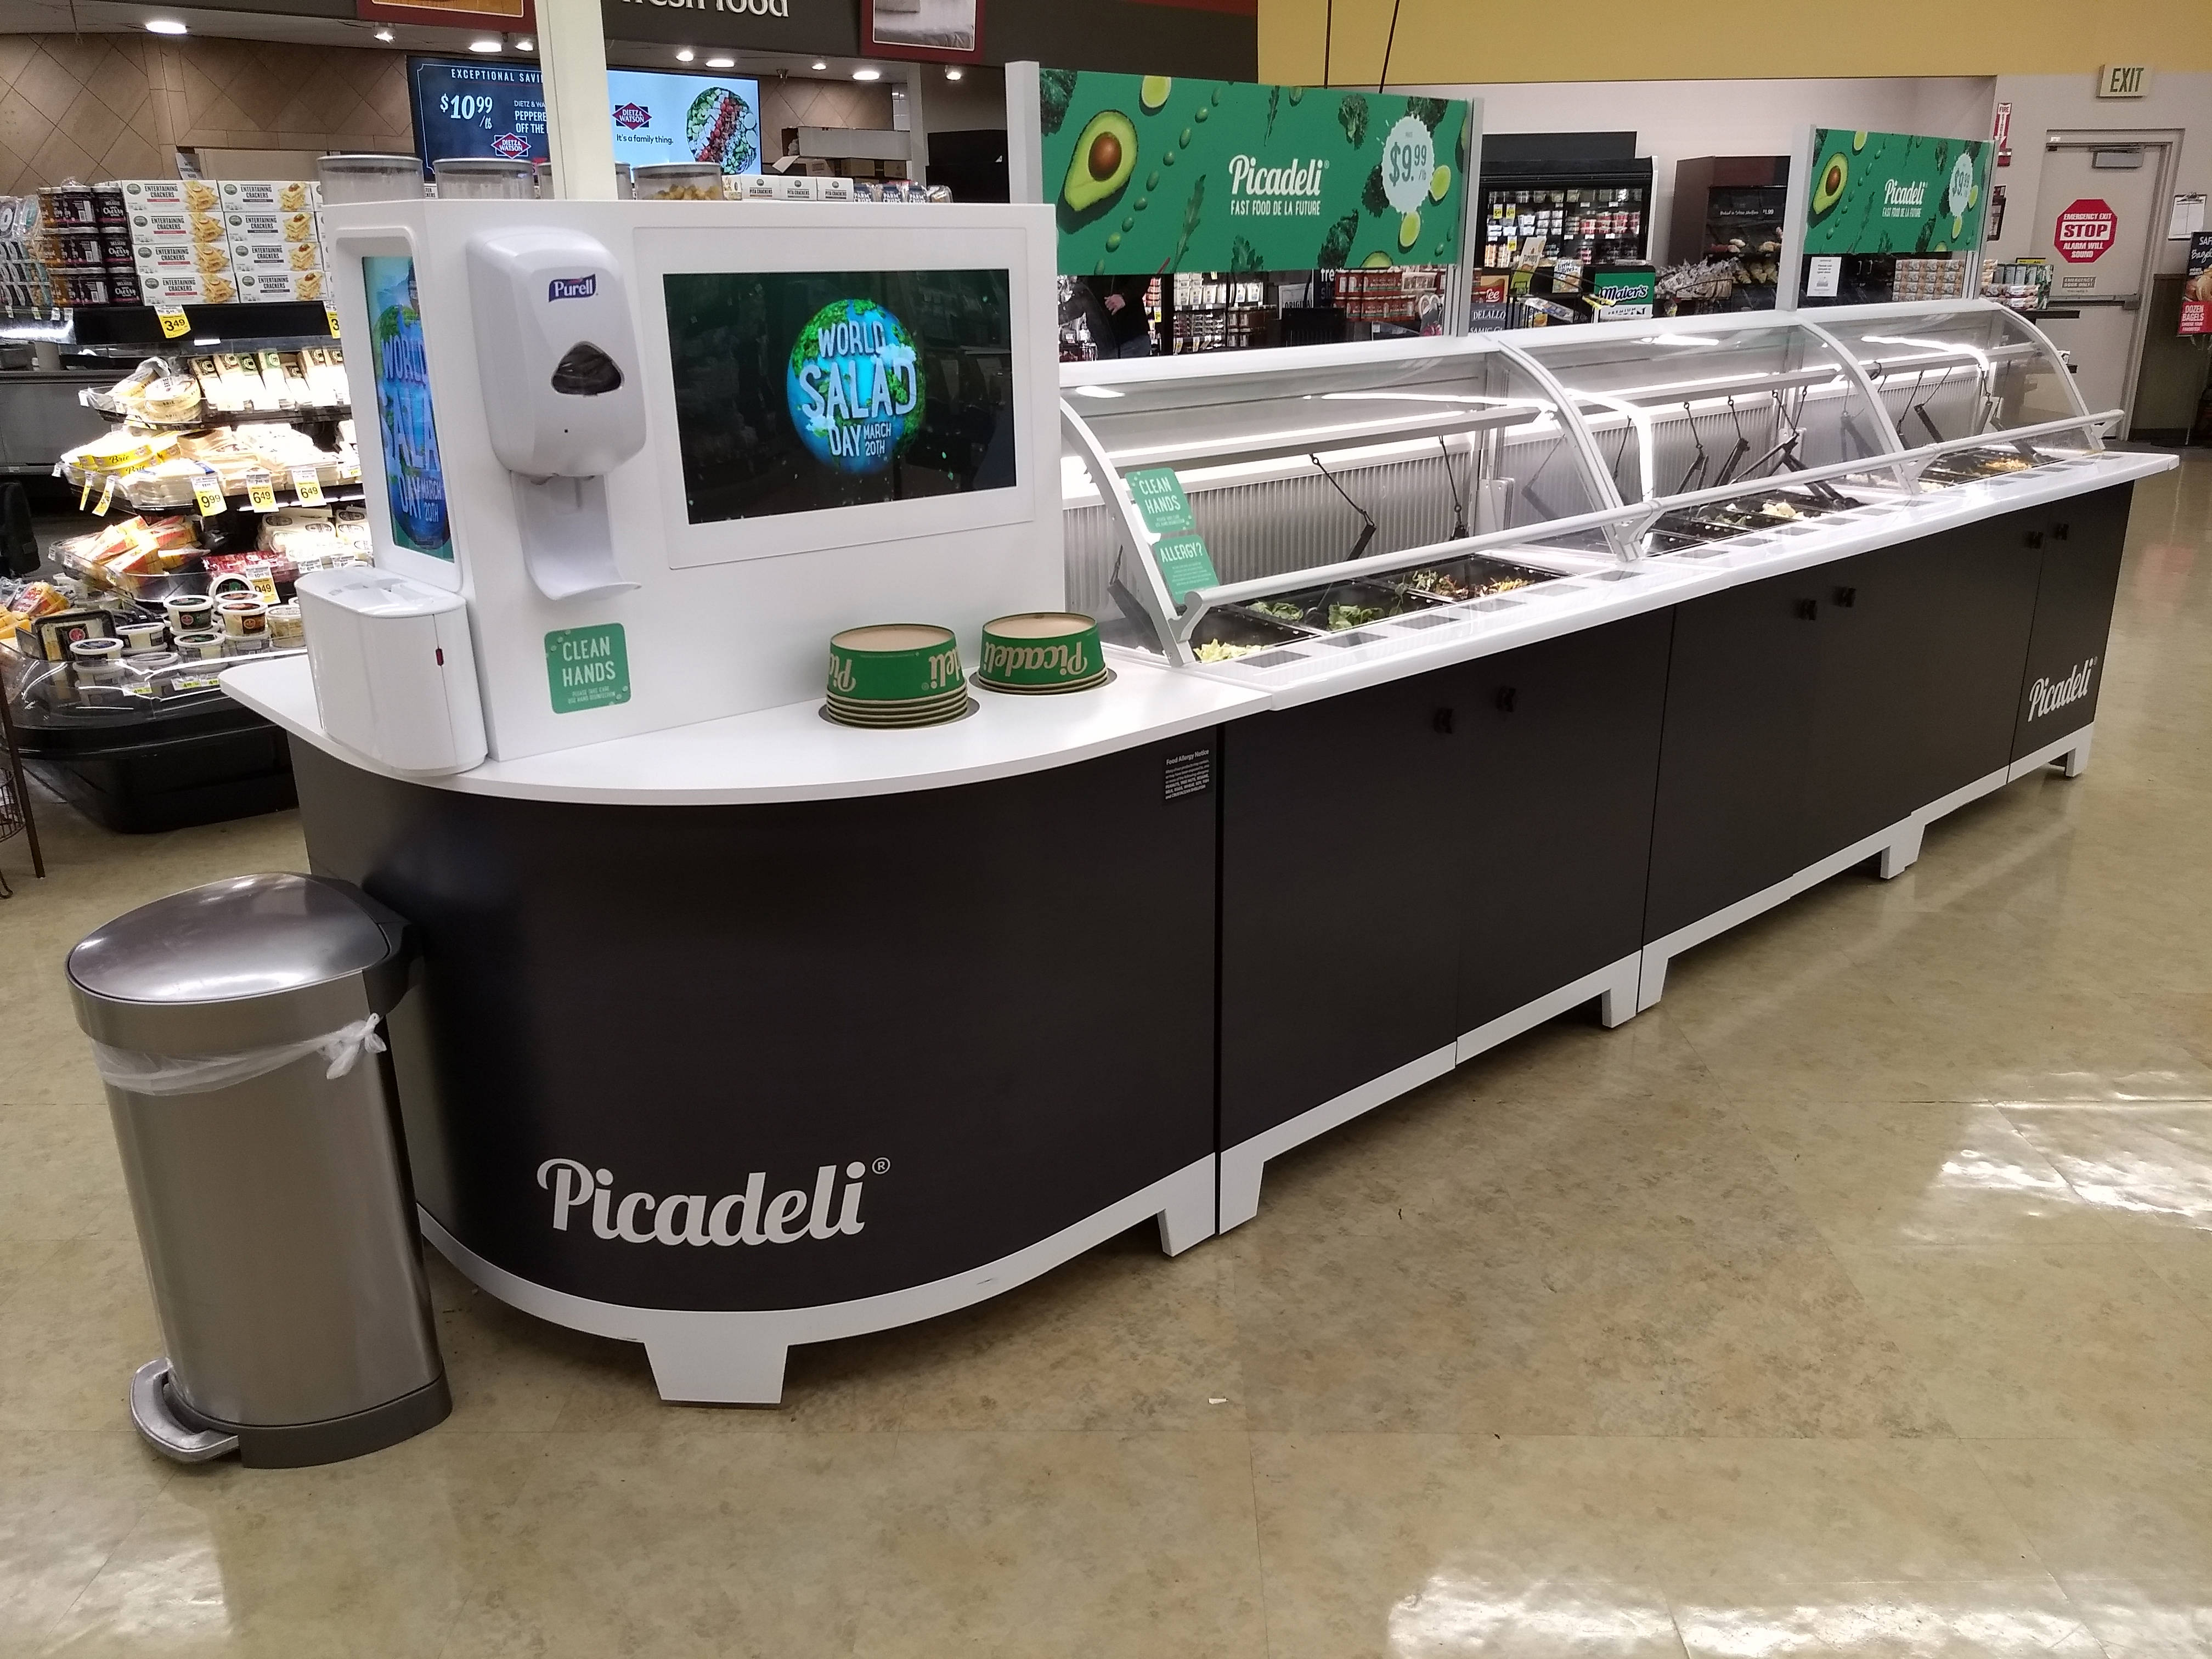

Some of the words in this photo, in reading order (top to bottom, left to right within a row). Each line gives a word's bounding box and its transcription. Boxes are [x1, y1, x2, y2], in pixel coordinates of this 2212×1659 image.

[451, 68, 515, 82] EXCEPTIONAL
[519, 73, 543, 83] SAVI
[2109, 67, 2144, 92] EXIT
[516, 123, 529, 133] OFF
[531, 123, 545, 134] THE
[633, 134, 654, 144] family
[654, 136, 674, 145] thing.
[1229, 154, 1323, 196] Picadeli
[1884, 179, 1926, 205] Picadeli
[1231, 200, 1250, 216] FAST
[1252, 200, 1271, 216] FOOD
[1273, 200, 1282, 216] DE
[1284, 200, 1293, 216] LA
[1295, 200, 1321, 216] FUTURE
[2063, 224, 2108, 238] STOP
[554, 278, 593, 297] Purell
[1601, 285, 1648, 301] Maier's
[1284, 300, 1313, 308] ORIGIAL
[2185, 304, 2204, 313] DOZEN
[1473, 310, 1506, 320] DELALLO
[2182, 313, 2204, 321] BAGELS
[818, 321, 885, 358] WORLD
[381, 335, 428, 383] WORLD
[799, 358, 917, 420] SALAD
[828, 425, 862, 457] DAY
[863, 422, 891, 440] MARCH
[865, 441, 885, 456] 20TH
[109, 455, 130, 464] Brie
[397, 472, 421, 520] DAY
[1139, 477, 1172, 495] CLEAN
[424, 502, 439, 522] 20TH
[1145, 495, 1181, 515] HANDS
[1160, 541, 1203, 563] ALLERGY?
[562, 636, 611, 661] CLEAN
[983, 640, 1088, 678] Picadeli
[562, 661, 616, 687] HANDS
[2028, 657, 2094, 723] Picadeli
[1166, 757, 1178, 765] Food
[1178, 753, 1195, 763] Allergy
[1194, 749, 1210, 758] Notice
[536, 1158, 866, 1247] Picadeli
